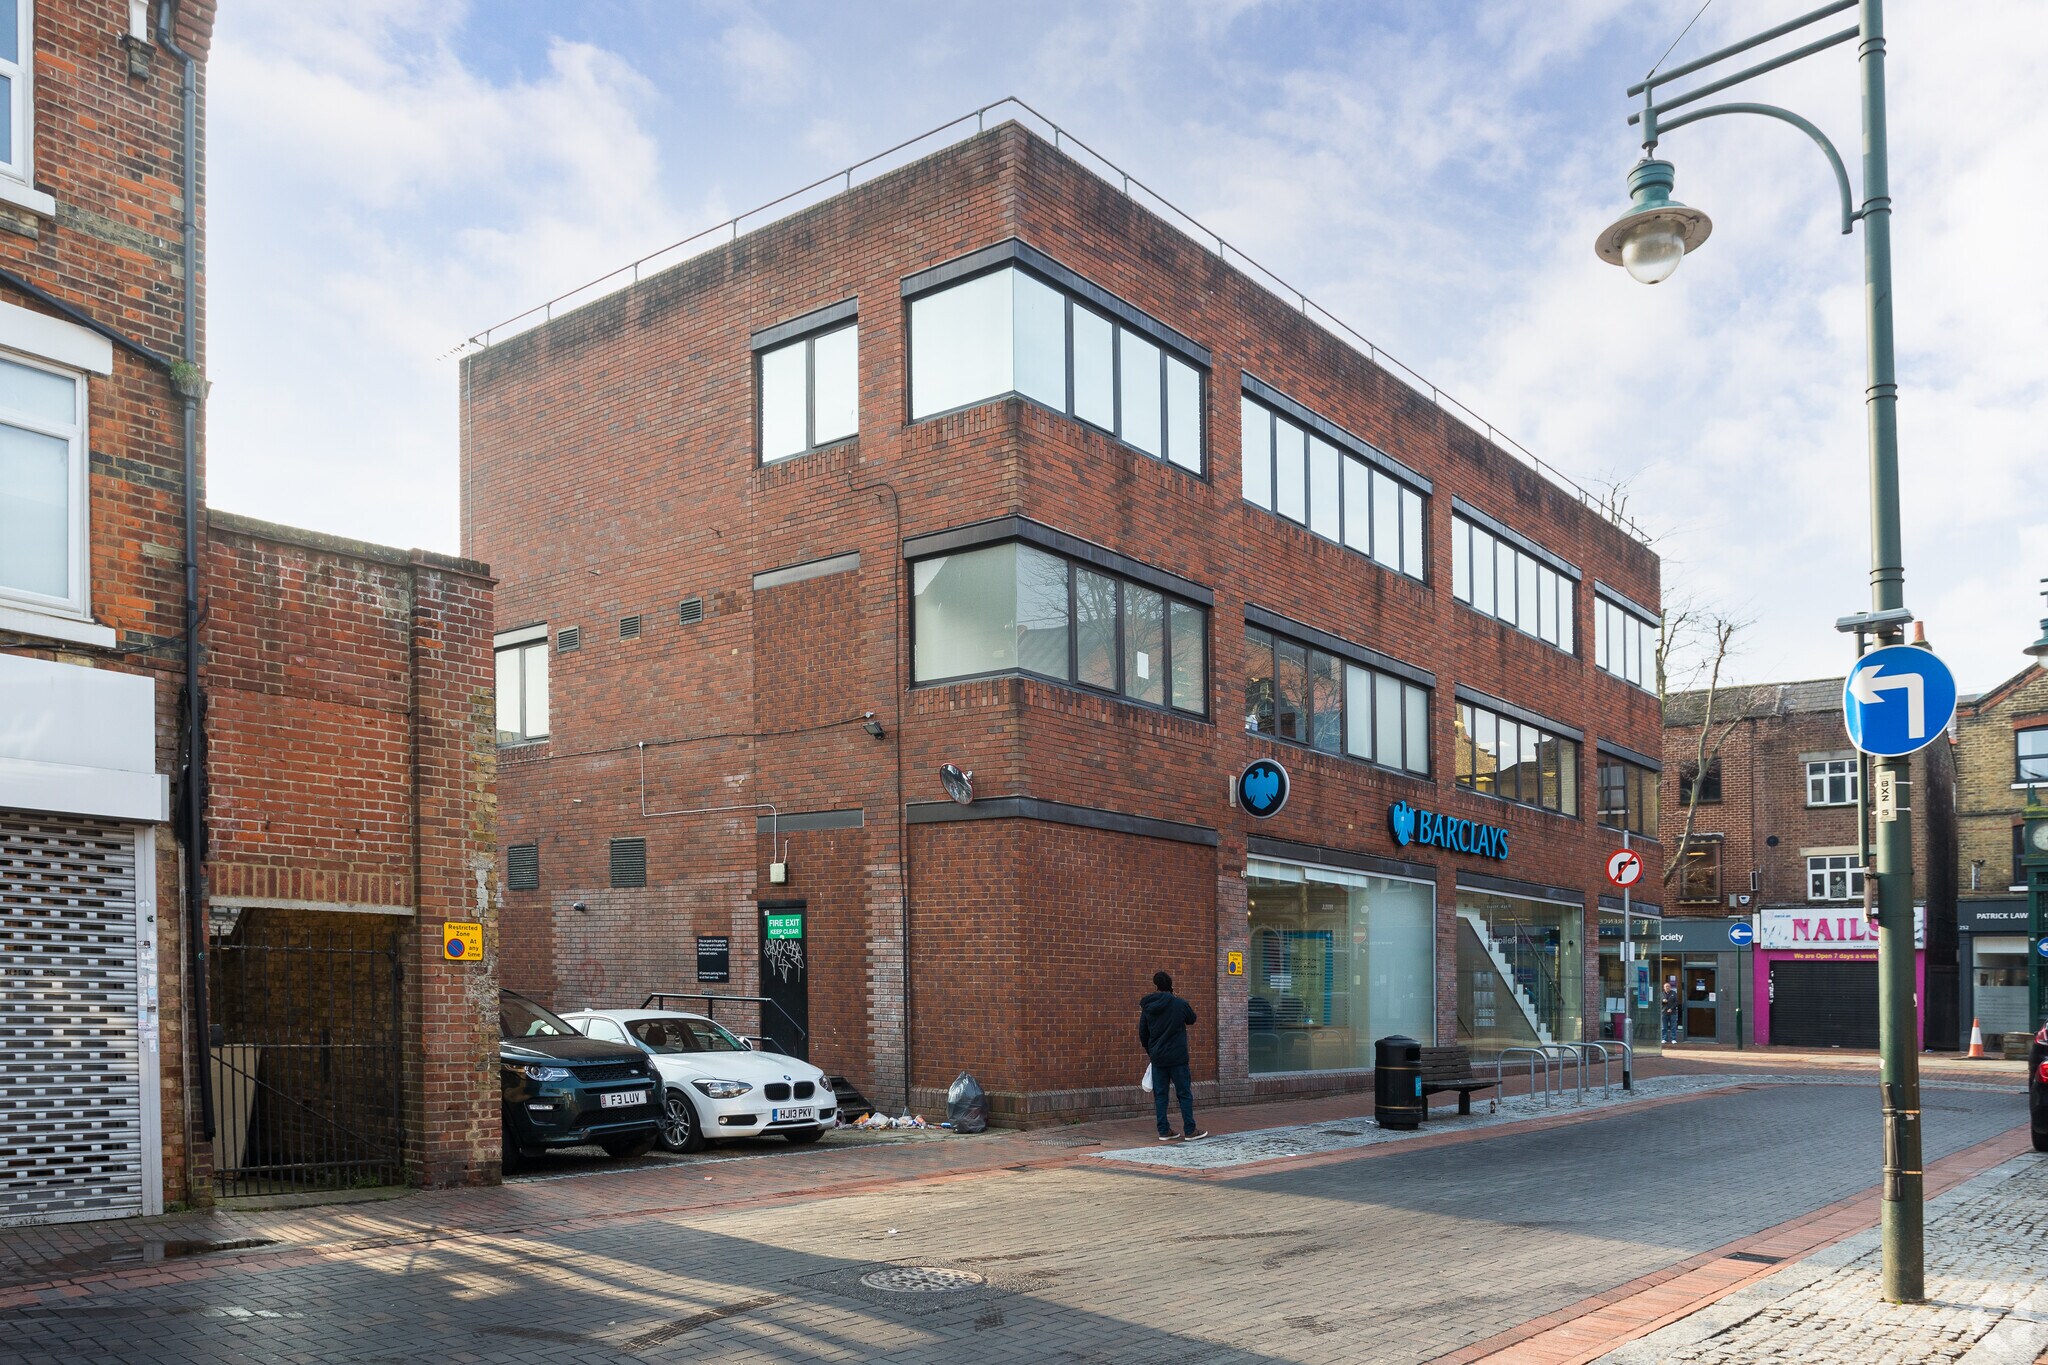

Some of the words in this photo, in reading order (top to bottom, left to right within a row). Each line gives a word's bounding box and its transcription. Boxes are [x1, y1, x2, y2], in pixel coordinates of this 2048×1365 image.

[1418, 809, 1510, 861] BARCLAYS
[1792, 918, 1879, 941] NAILS
[1660, 932, 1684, 942] ociety
[611, 1094, 623, 1105] F3
[624, 1092, 640, 1104] LUV
[780, 1109, 797, 1119] HJ13
[798, 1108, 812, 1118] PKV
